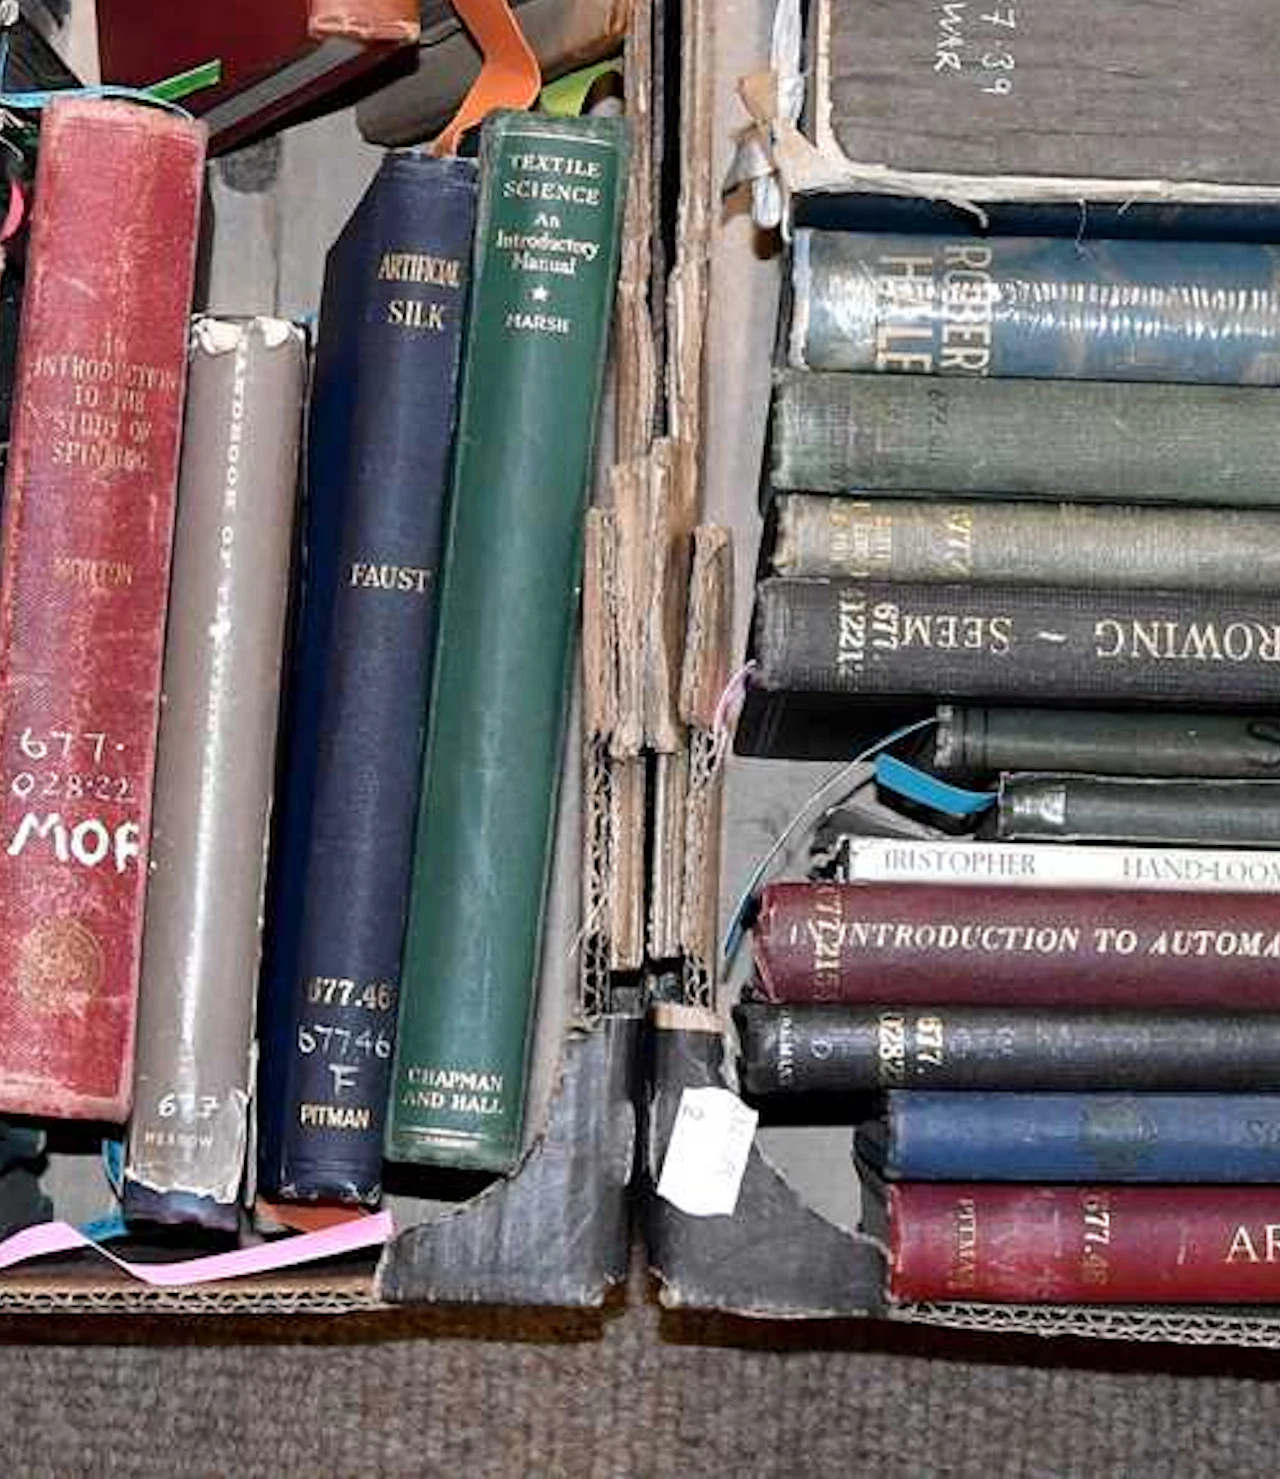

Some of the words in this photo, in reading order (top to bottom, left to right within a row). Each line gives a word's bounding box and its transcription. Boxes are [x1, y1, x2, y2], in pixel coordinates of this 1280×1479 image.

[510, 153, 602, 179] TEXTILE
[501, 178, 602, 207] SCIENCE
[533, 211, 562, 229] An
[495, 227, 600, 262] Introductory
[511, 252, 577, 276] Manual
[386, 299, 445, 330] SILK
[504, 311, 570, 335] MARSH
[876, 255, 935, 373] HALE
[350, 563, 430, 592] FAUST
[841, 922, 1084, 955] INTRODUCTION
[1096, 929, 1140, 956] TO
[406, 1066, 504, 1092] CHAPMAN
[402, 1087, 443, 1109] AND
[451, 1091, 504, 1115] HALL
[299, 1104, 371, 1130] PITMAN
